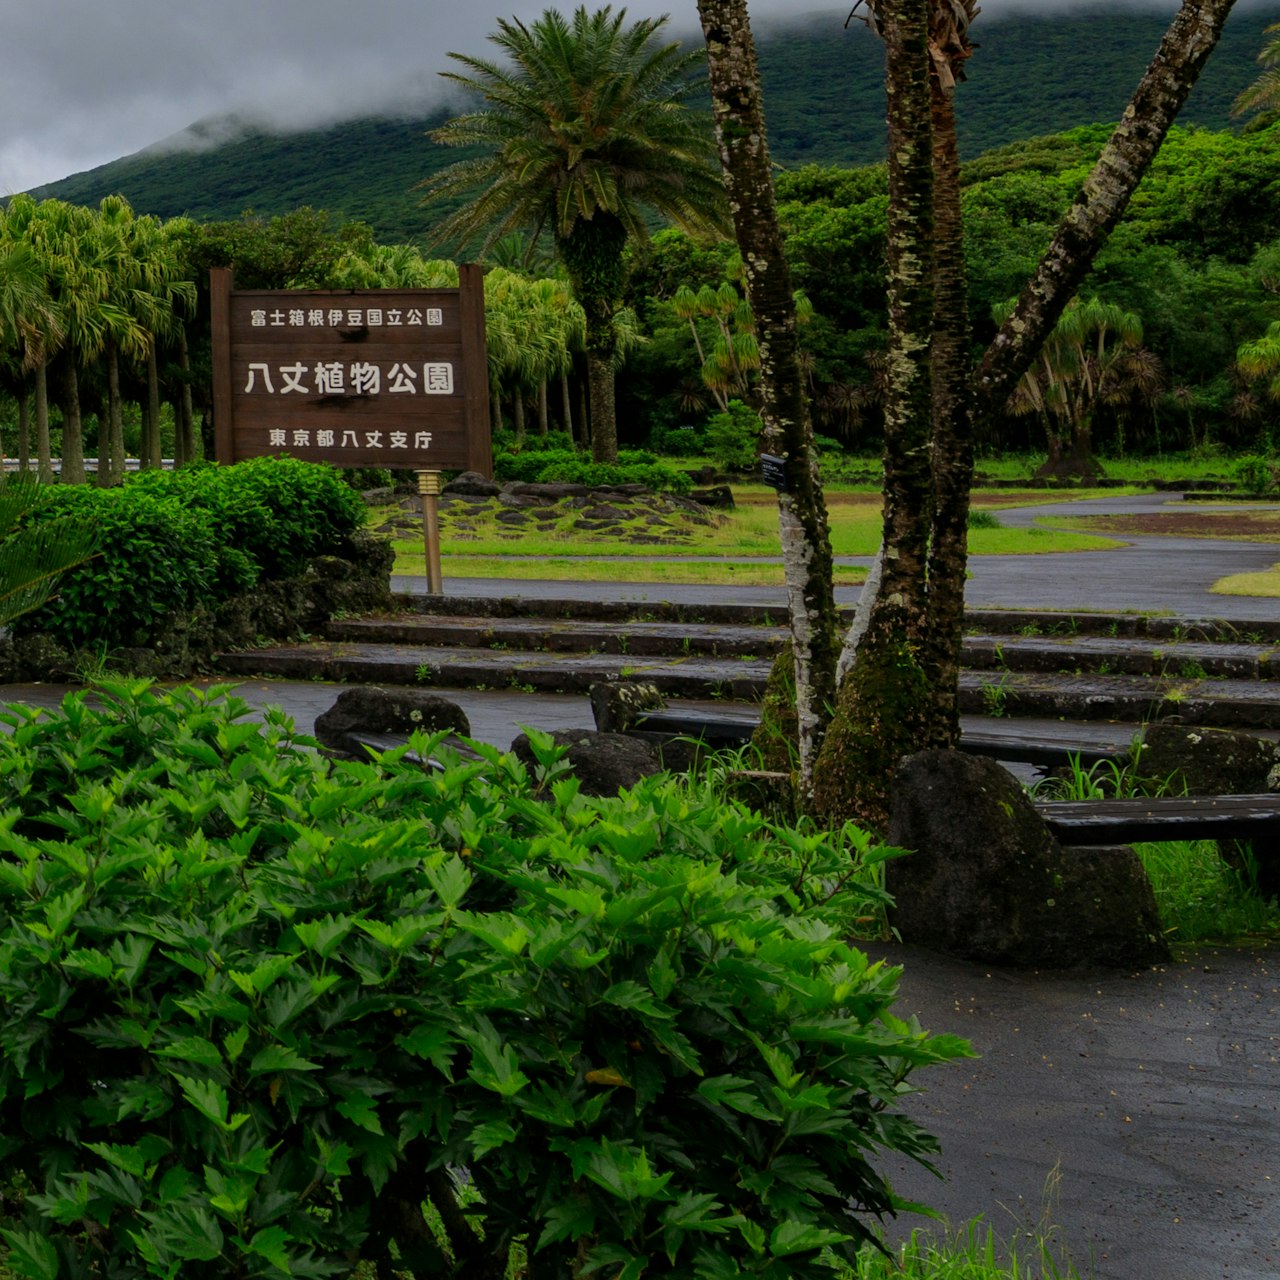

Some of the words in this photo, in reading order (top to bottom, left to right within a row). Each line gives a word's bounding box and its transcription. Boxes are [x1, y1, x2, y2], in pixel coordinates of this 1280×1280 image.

[250, 308, 444, 327] 富士箱根伊豆国立公園
[244, 362, 455, 395] 八丈植物公園
[269, 429, 433, 450] 東京都八丈支庁
